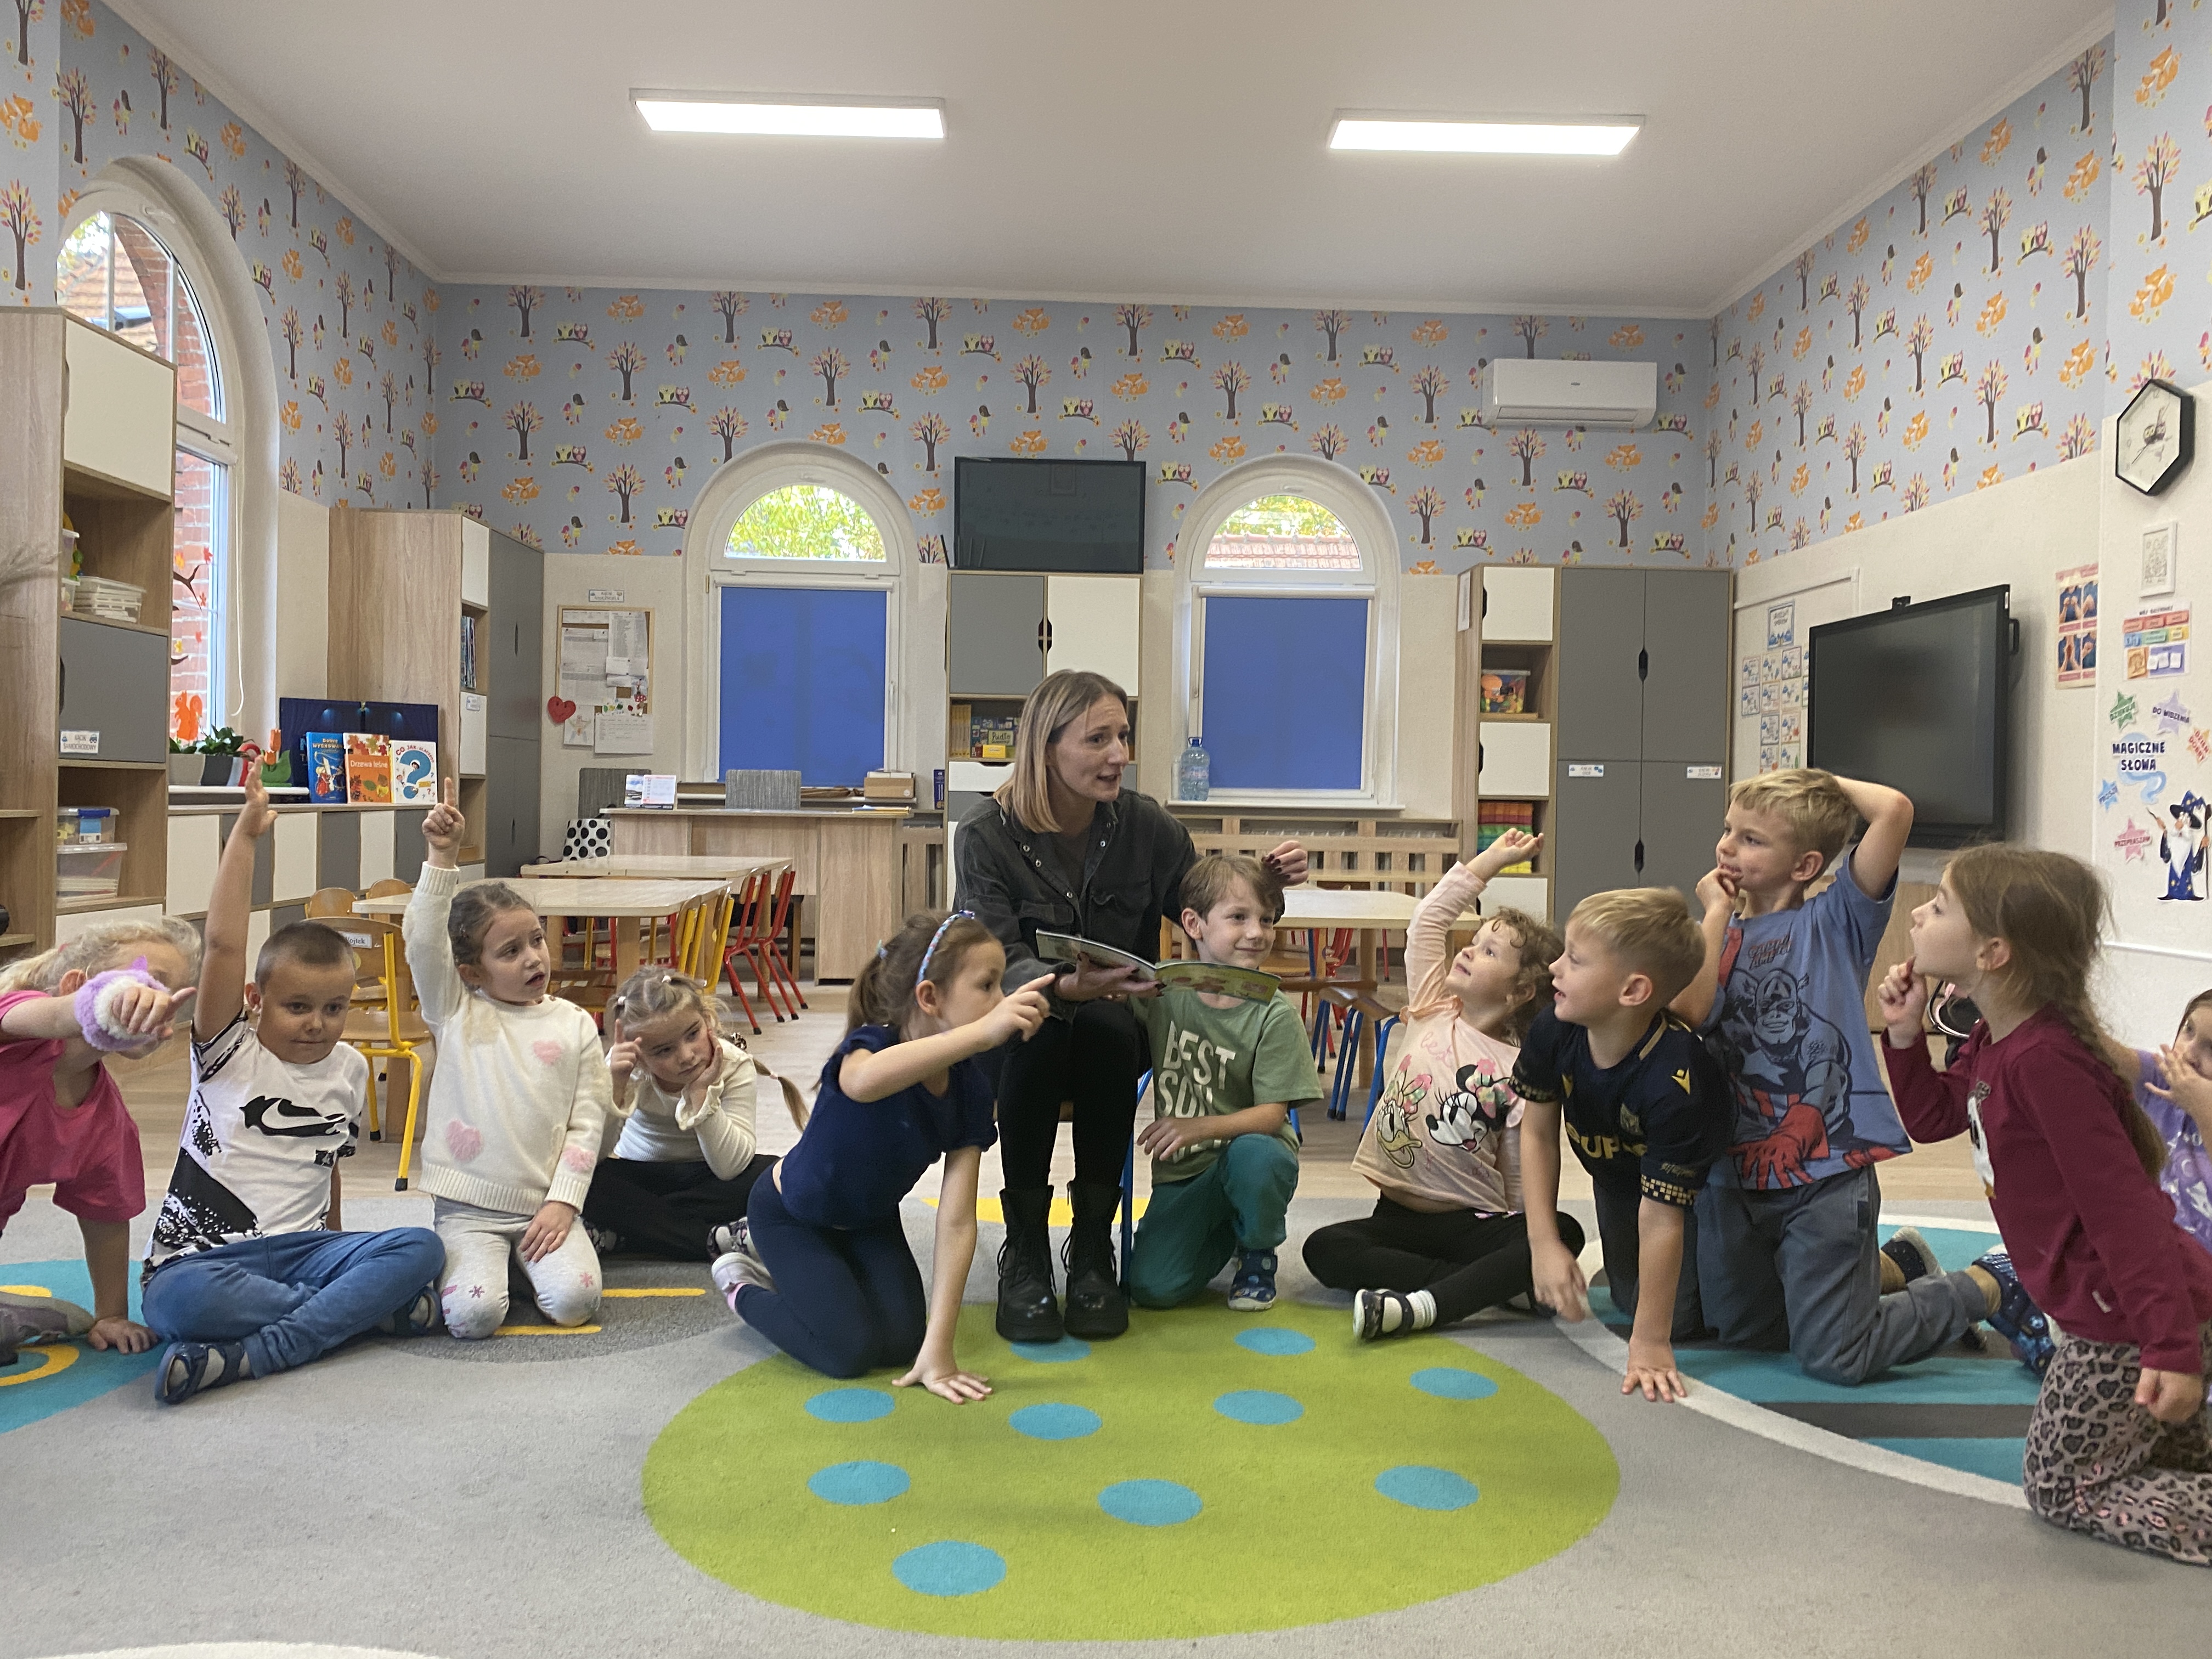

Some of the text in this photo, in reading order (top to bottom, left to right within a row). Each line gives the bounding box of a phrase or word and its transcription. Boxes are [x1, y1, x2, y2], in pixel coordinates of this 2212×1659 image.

[2152, 706, 2190, 723] DO WIDZENIA
[396, 747, 405, 755] CO
[2112, 742, 2165, 754] MAGICZNE
[2121, 759, 2157, 771] SŁOWA
[1163, 1020, 1237, 1091] BEST
